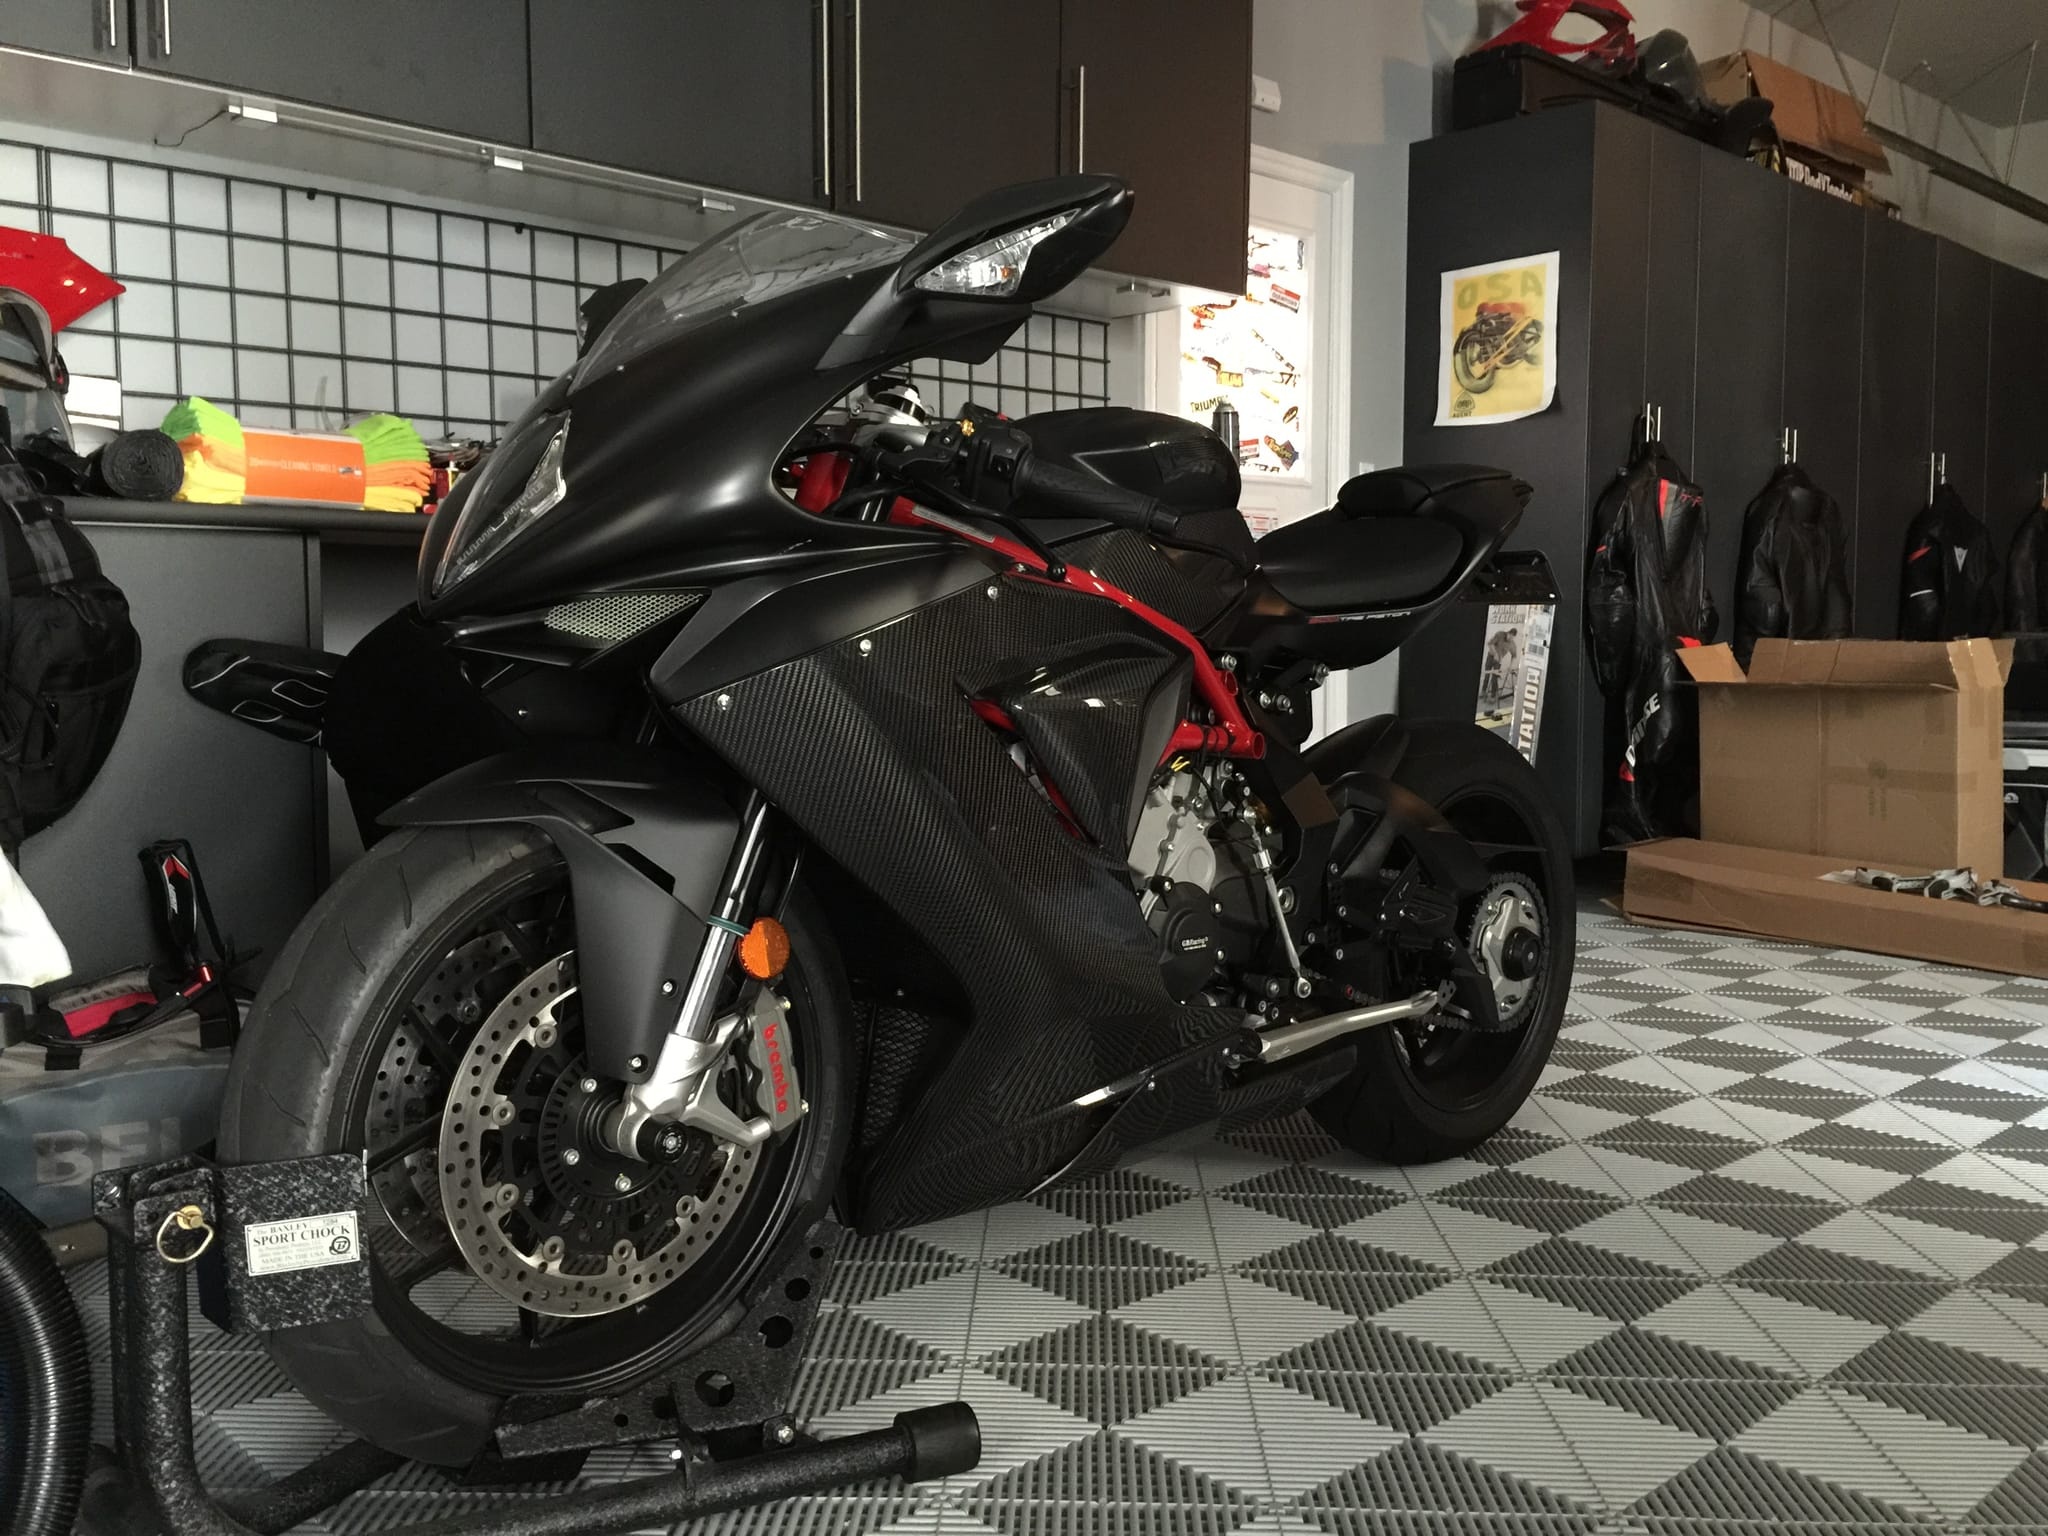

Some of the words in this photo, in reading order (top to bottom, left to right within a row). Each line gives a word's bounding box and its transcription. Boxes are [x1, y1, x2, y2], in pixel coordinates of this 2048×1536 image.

[1190, 394, 1228, 413] TRIUMP
[763, 1023, 789, 1113] brembo
[253, 1232, 297, 1246] SPORT
[301, 1225, 350, 1241] CHOCK
[270, 1223, 308, 1233] BAXLEY
